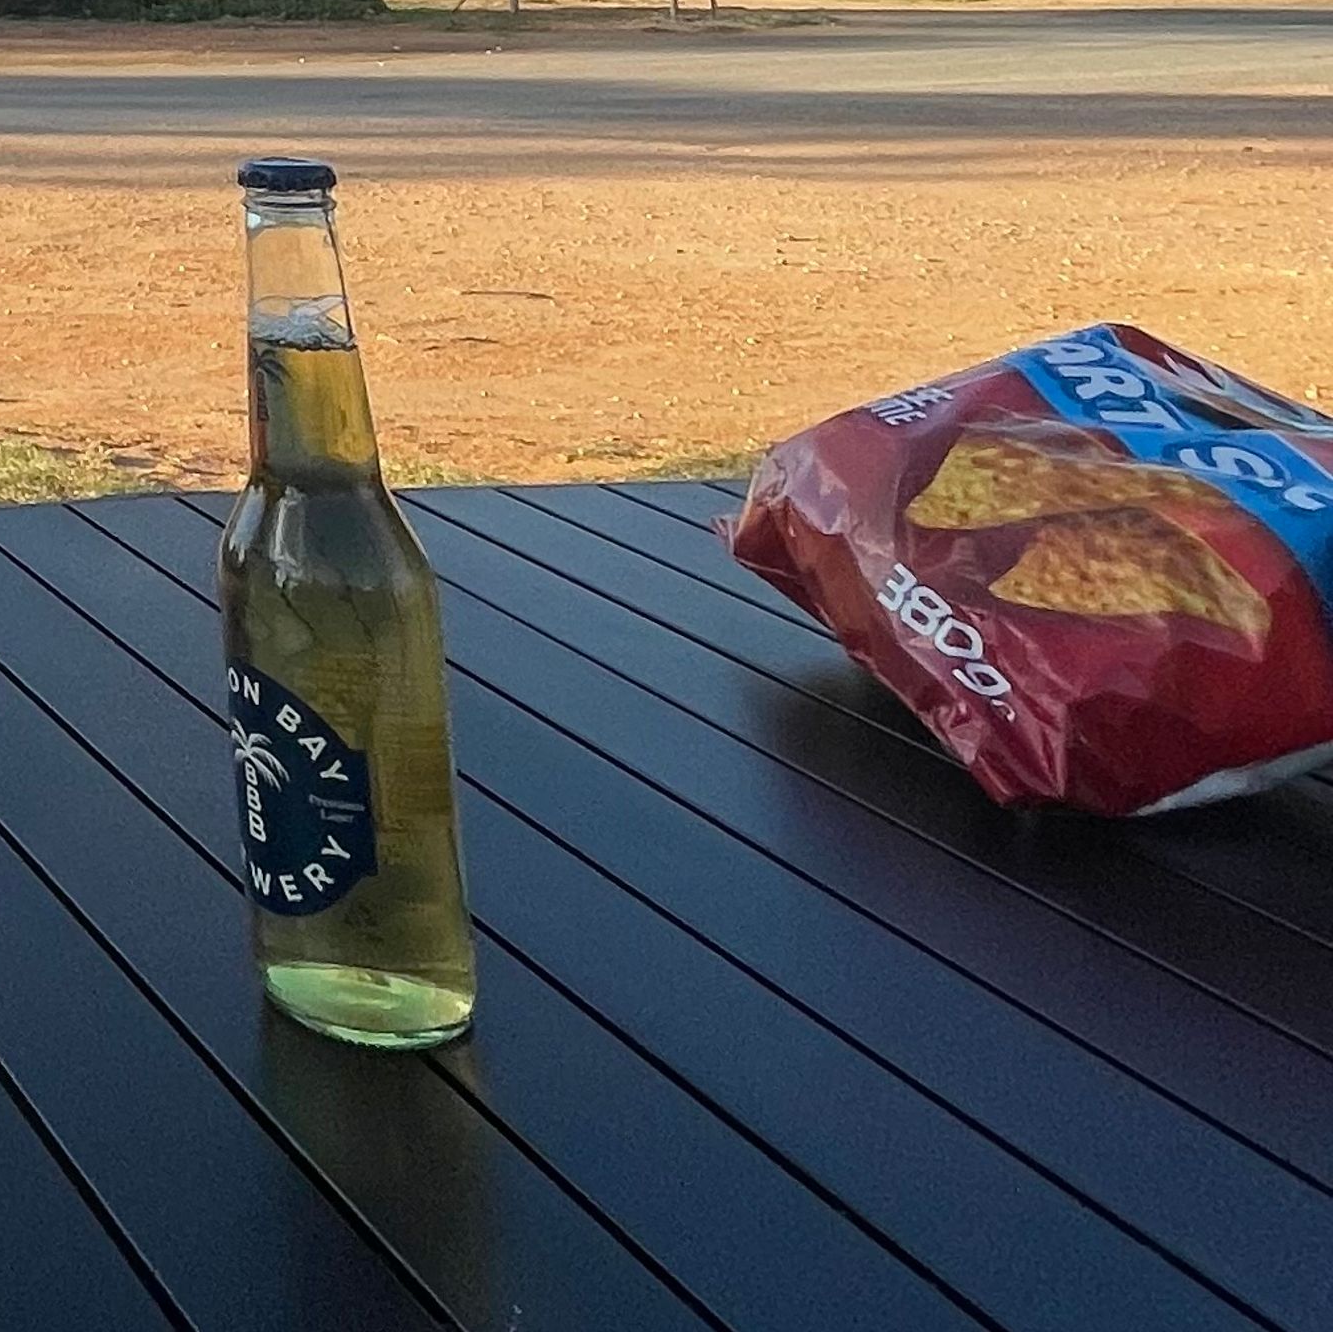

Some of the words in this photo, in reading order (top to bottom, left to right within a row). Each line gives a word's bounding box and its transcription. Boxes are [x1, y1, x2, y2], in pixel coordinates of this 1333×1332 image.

[276, 704, 349, 781] BAY
[244, 760, 267, 843] BBB
[241, 834, 351, 903] WERY
